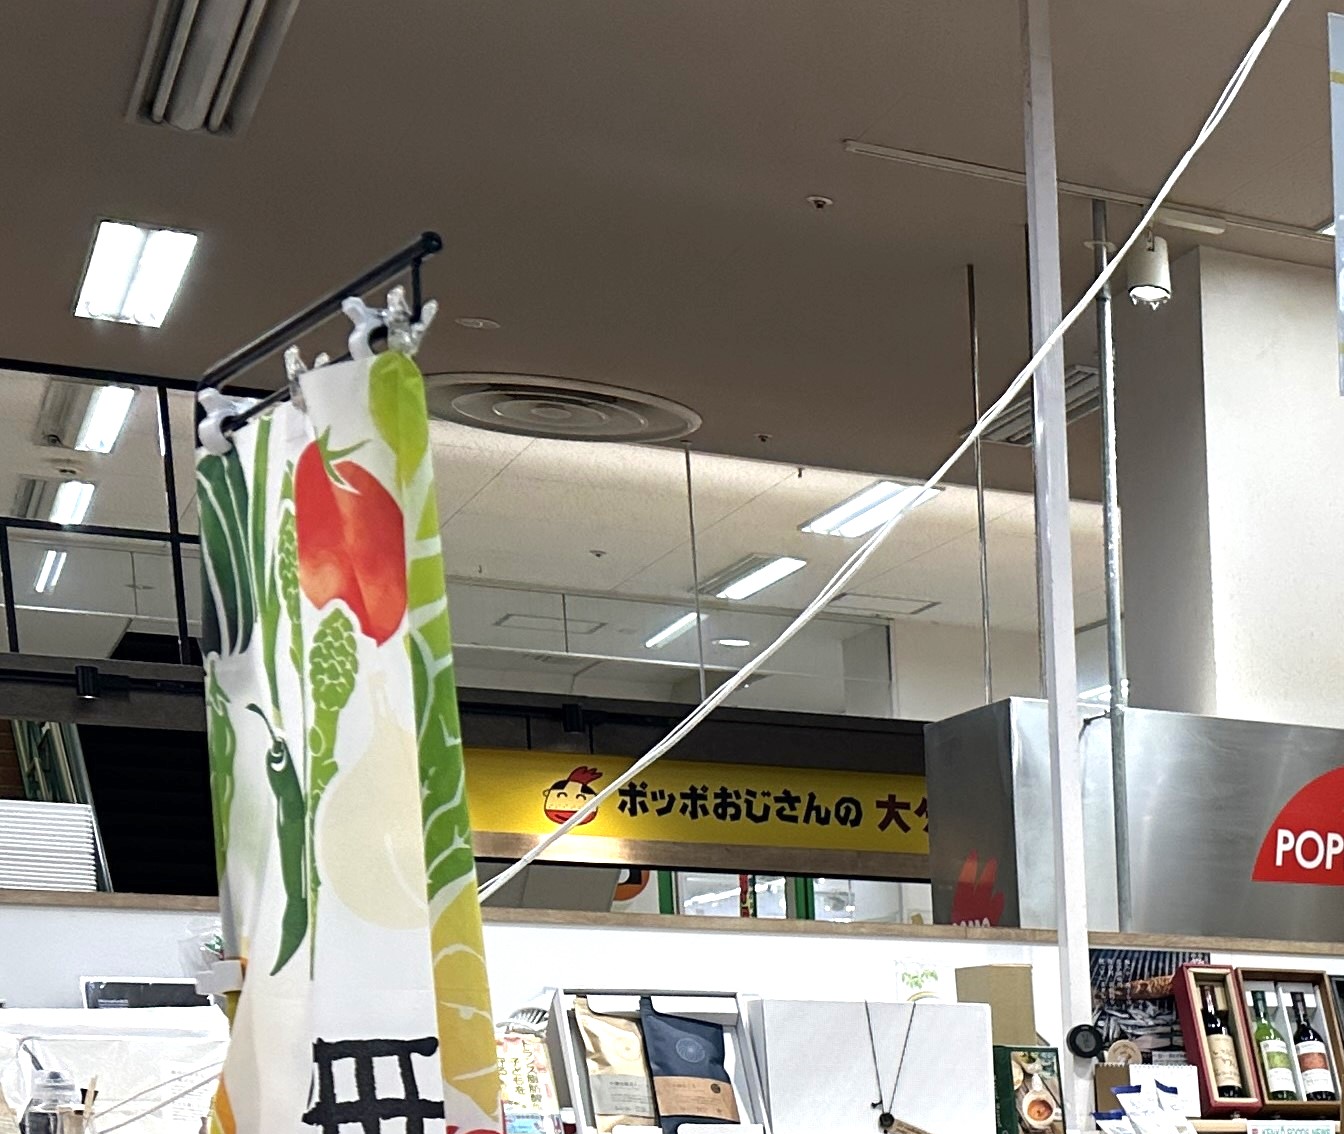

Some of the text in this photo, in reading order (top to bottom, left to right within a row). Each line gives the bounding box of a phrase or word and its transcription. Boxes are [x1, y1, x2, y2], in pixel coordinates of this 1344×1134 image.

[617, 781, 864, 828] ポッポおじさんの
